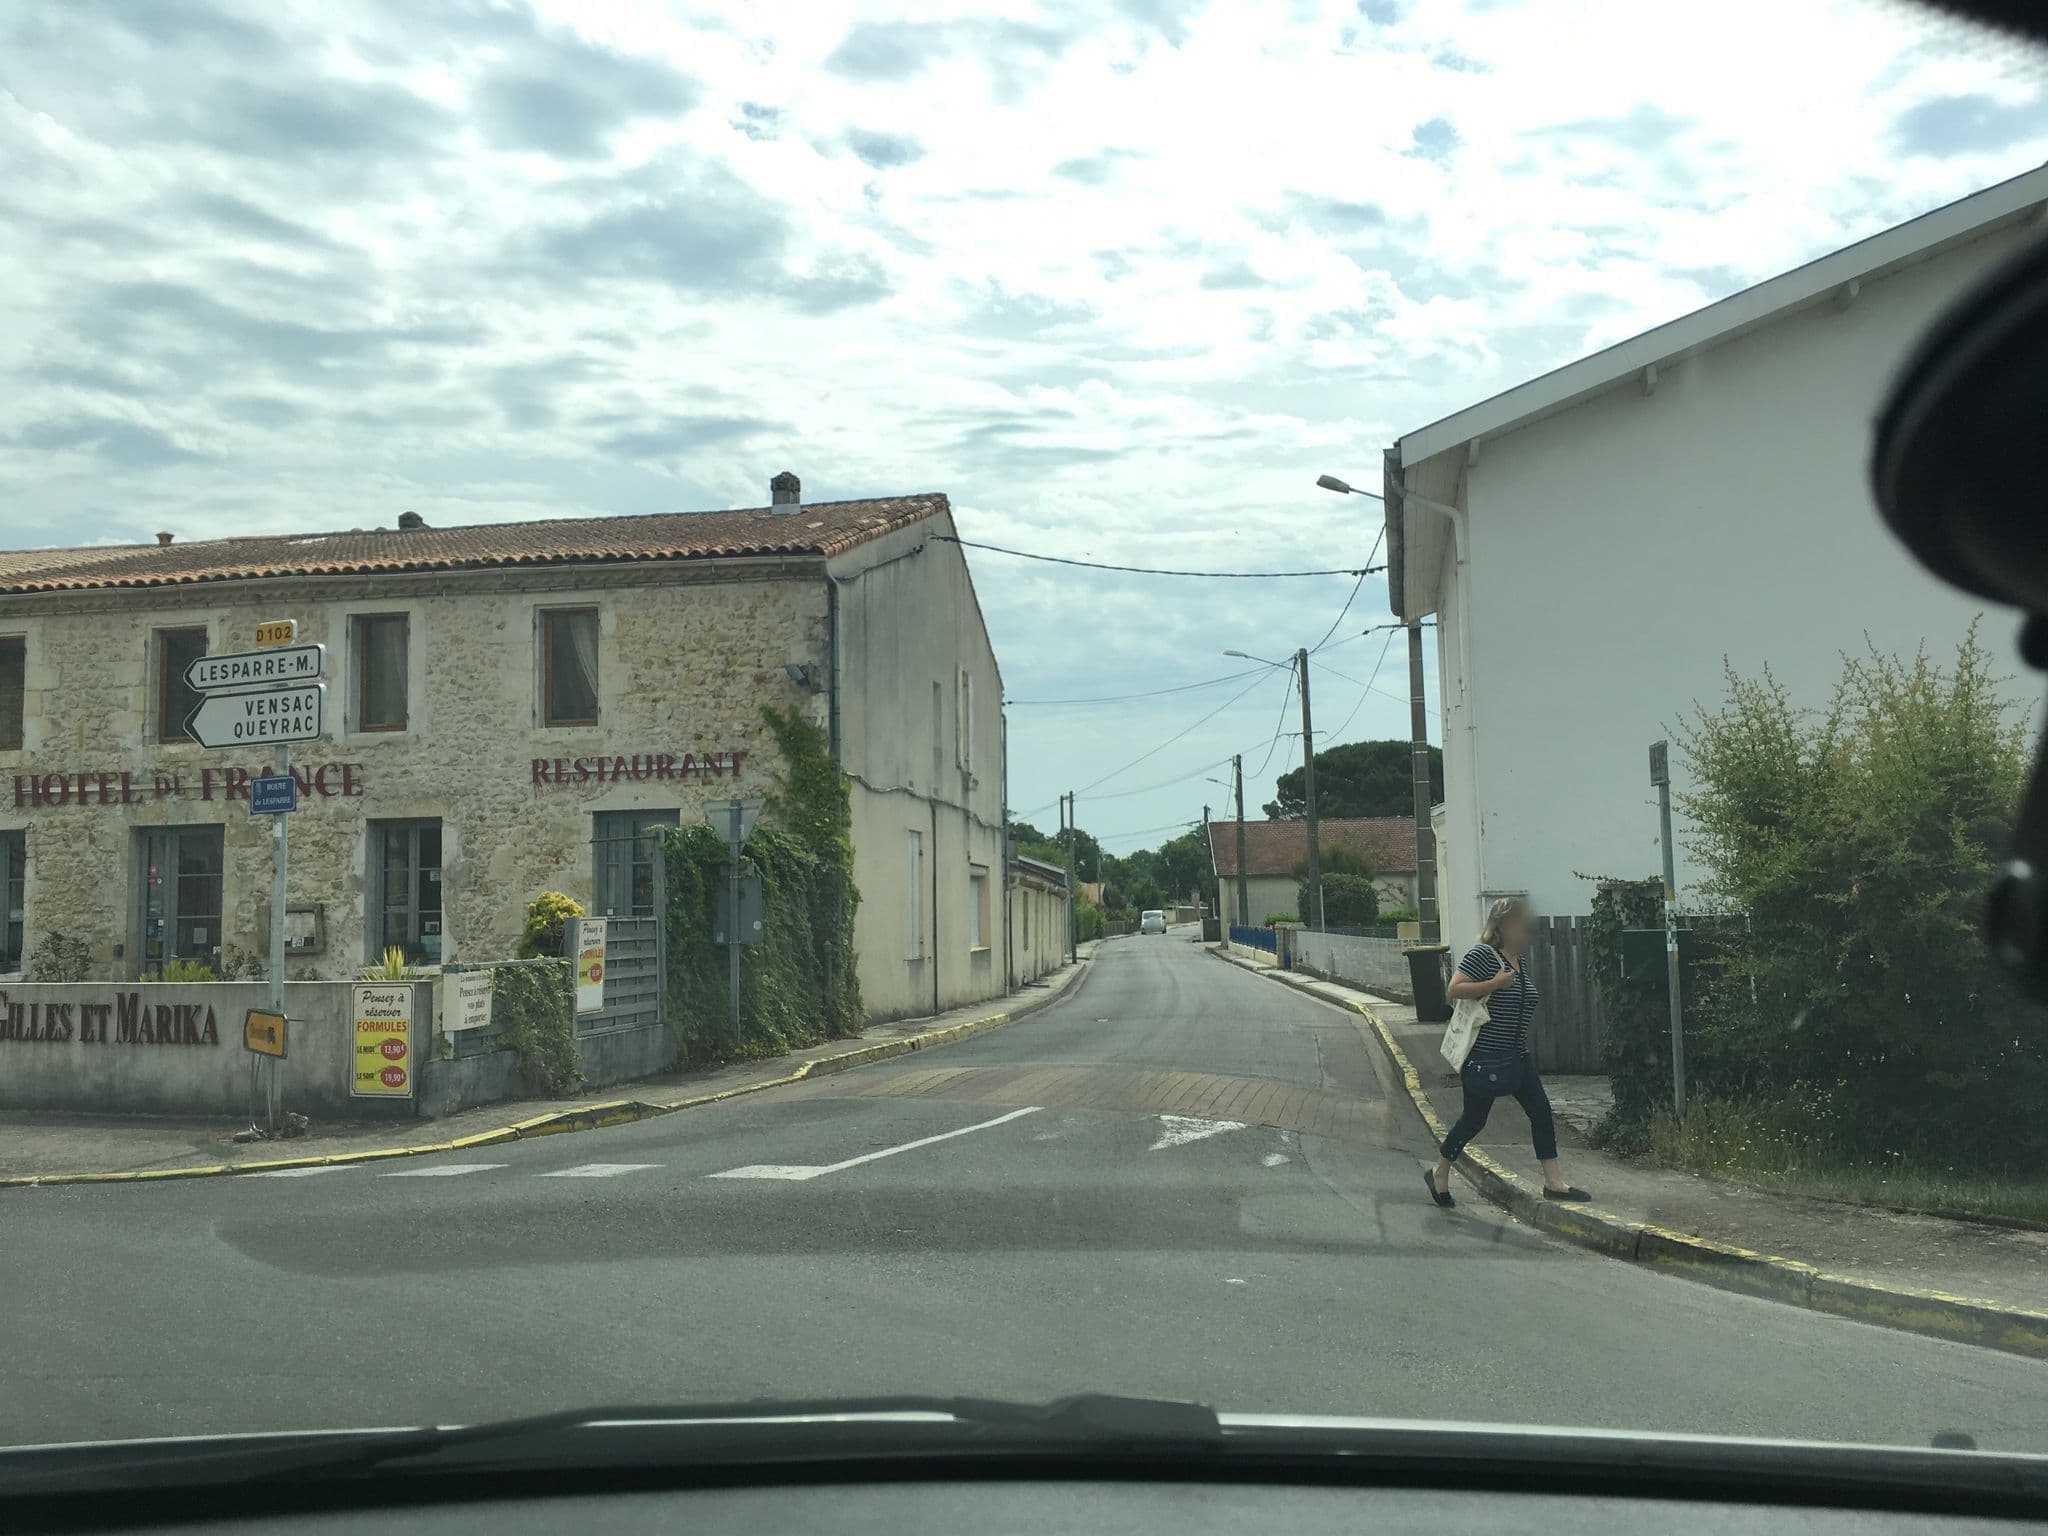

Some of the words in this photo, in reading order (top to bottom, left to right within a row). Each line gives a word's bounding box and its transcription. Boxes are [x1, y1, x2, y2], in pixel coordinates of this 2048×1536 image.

[256, 630, 264, 642] D
[268, 626, 292, 640] 102
[200, 655, 314, 682] LESPARRE-M.
[245, 694, 314, 717] VENSAC
[234, 716, 313, 739] QUEYRAC
[531, 751, 748, 784] RESTAURANT
[13, 772, 143, 807] HOTEL
[361, 990, 394, 1006] Pensez
[397, 992, 405, 1003] à
[79, 1003, 113, 1044] ET
[364, 1007, 401, 1017] réserver
[356, 1021, 407, 1033] FORMULES
